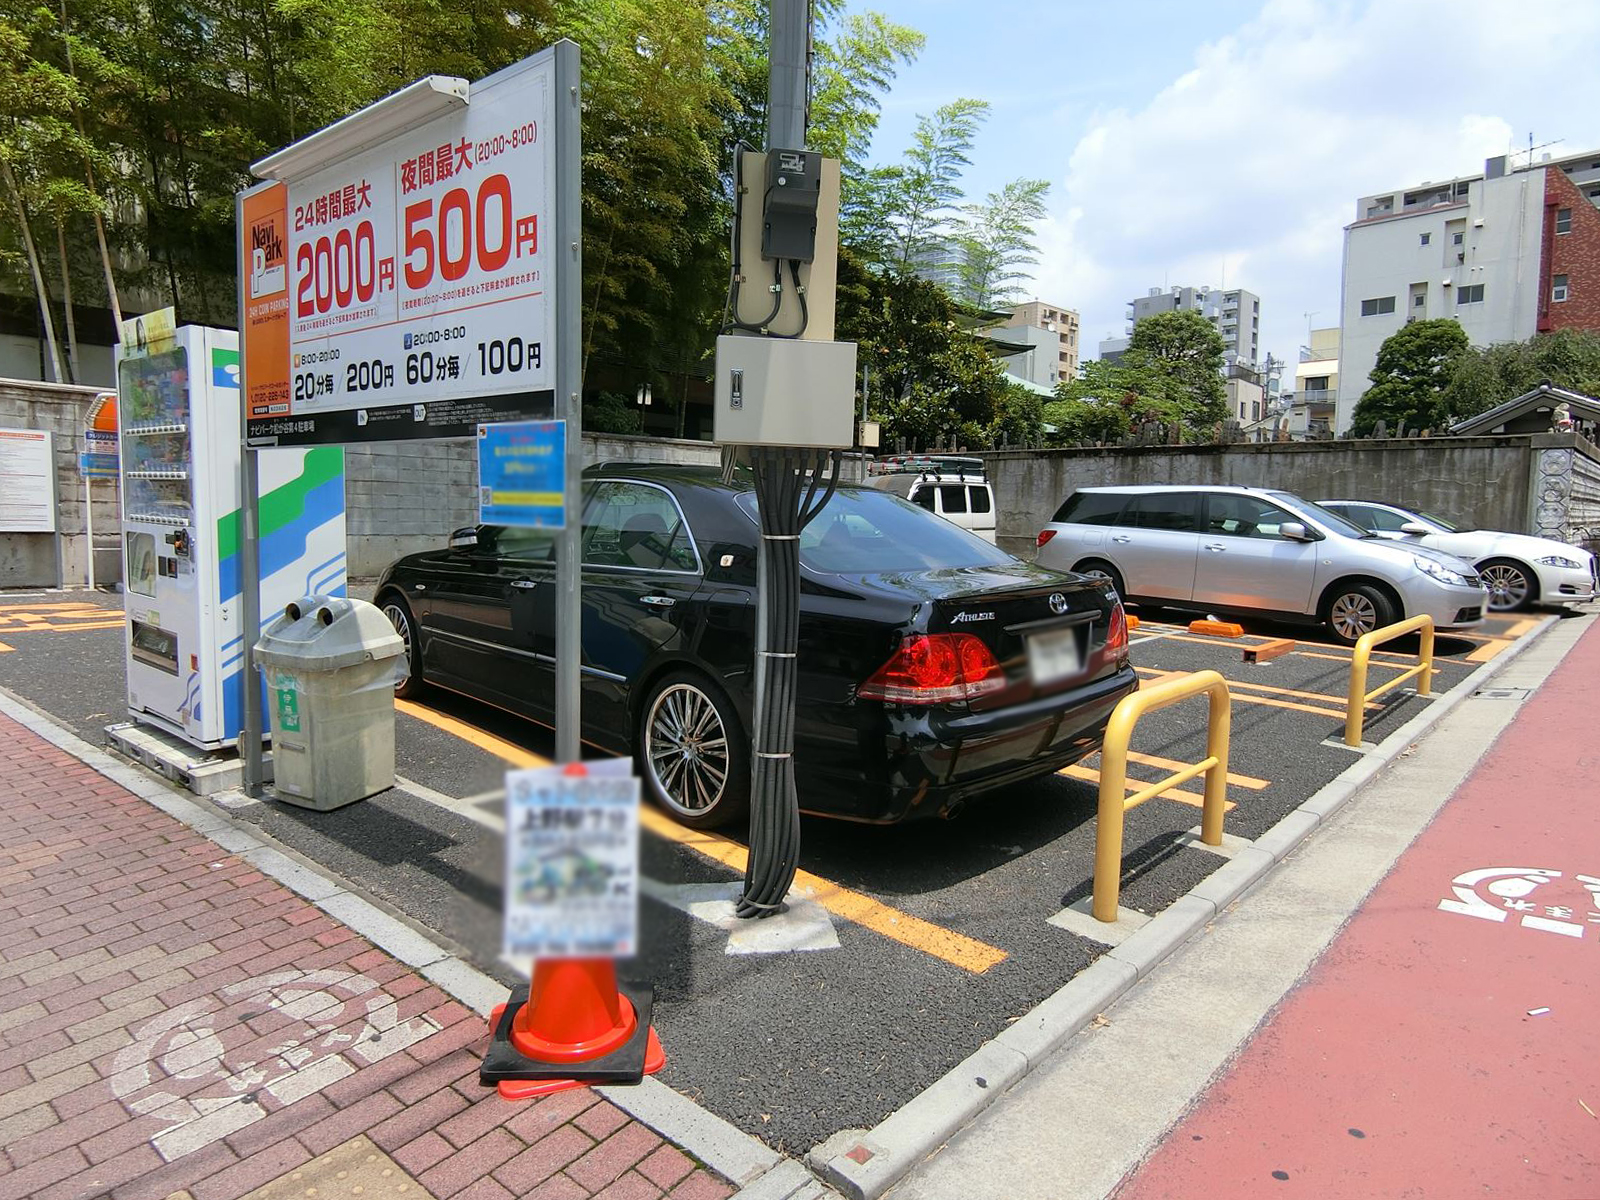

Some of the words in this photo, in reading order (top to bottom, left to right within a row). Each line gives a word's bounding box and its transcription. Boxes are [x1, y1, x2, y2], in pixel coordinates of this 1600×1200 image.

[401, 137, 473, 195] 夜間最大
[253, 219, 274, 248] Navi
[295, 179, 371, 232] 24時間最大
[405, 173, 537, 290] 500円
[297, 220, 394, 318] 2000円
